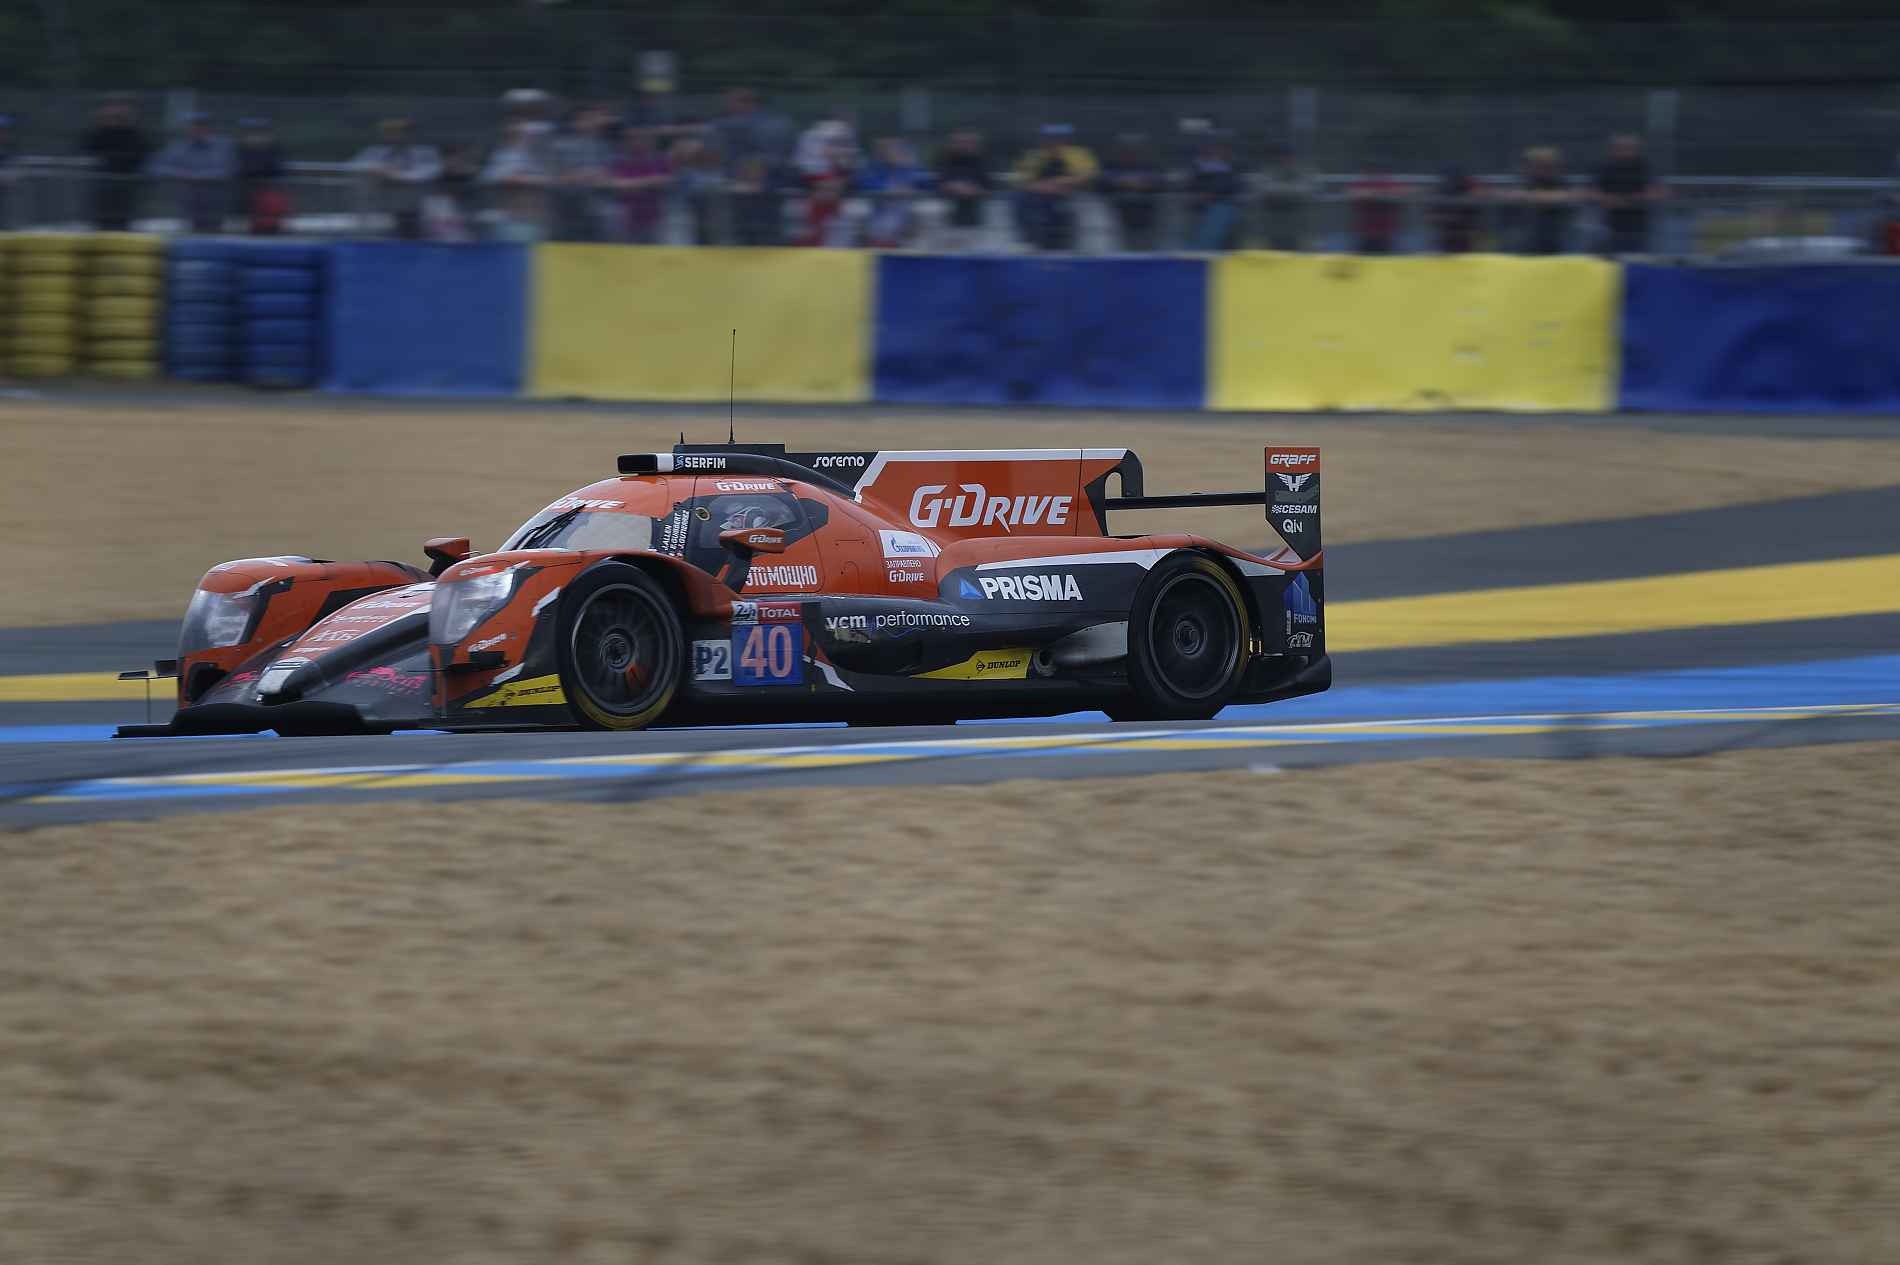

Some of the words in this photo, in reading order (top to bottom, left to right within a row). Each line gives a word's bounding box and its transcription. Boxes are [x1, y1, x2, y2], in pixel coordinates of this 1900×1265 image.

[684, 457, 726, 469] SERFIM
[1281, 504, 1318, 514] CESAM
[978, 574, 1083, 601] PRISMA
[759, 606, 800, 618] TOTAL
[825, 615, 867, 629] vcm
[875, 610, 971, 628] performance
[740, 626, 793, 678] 40
[695, 646, 730, 676] P2
[987, 660, 1020, 670] DUNLOP
